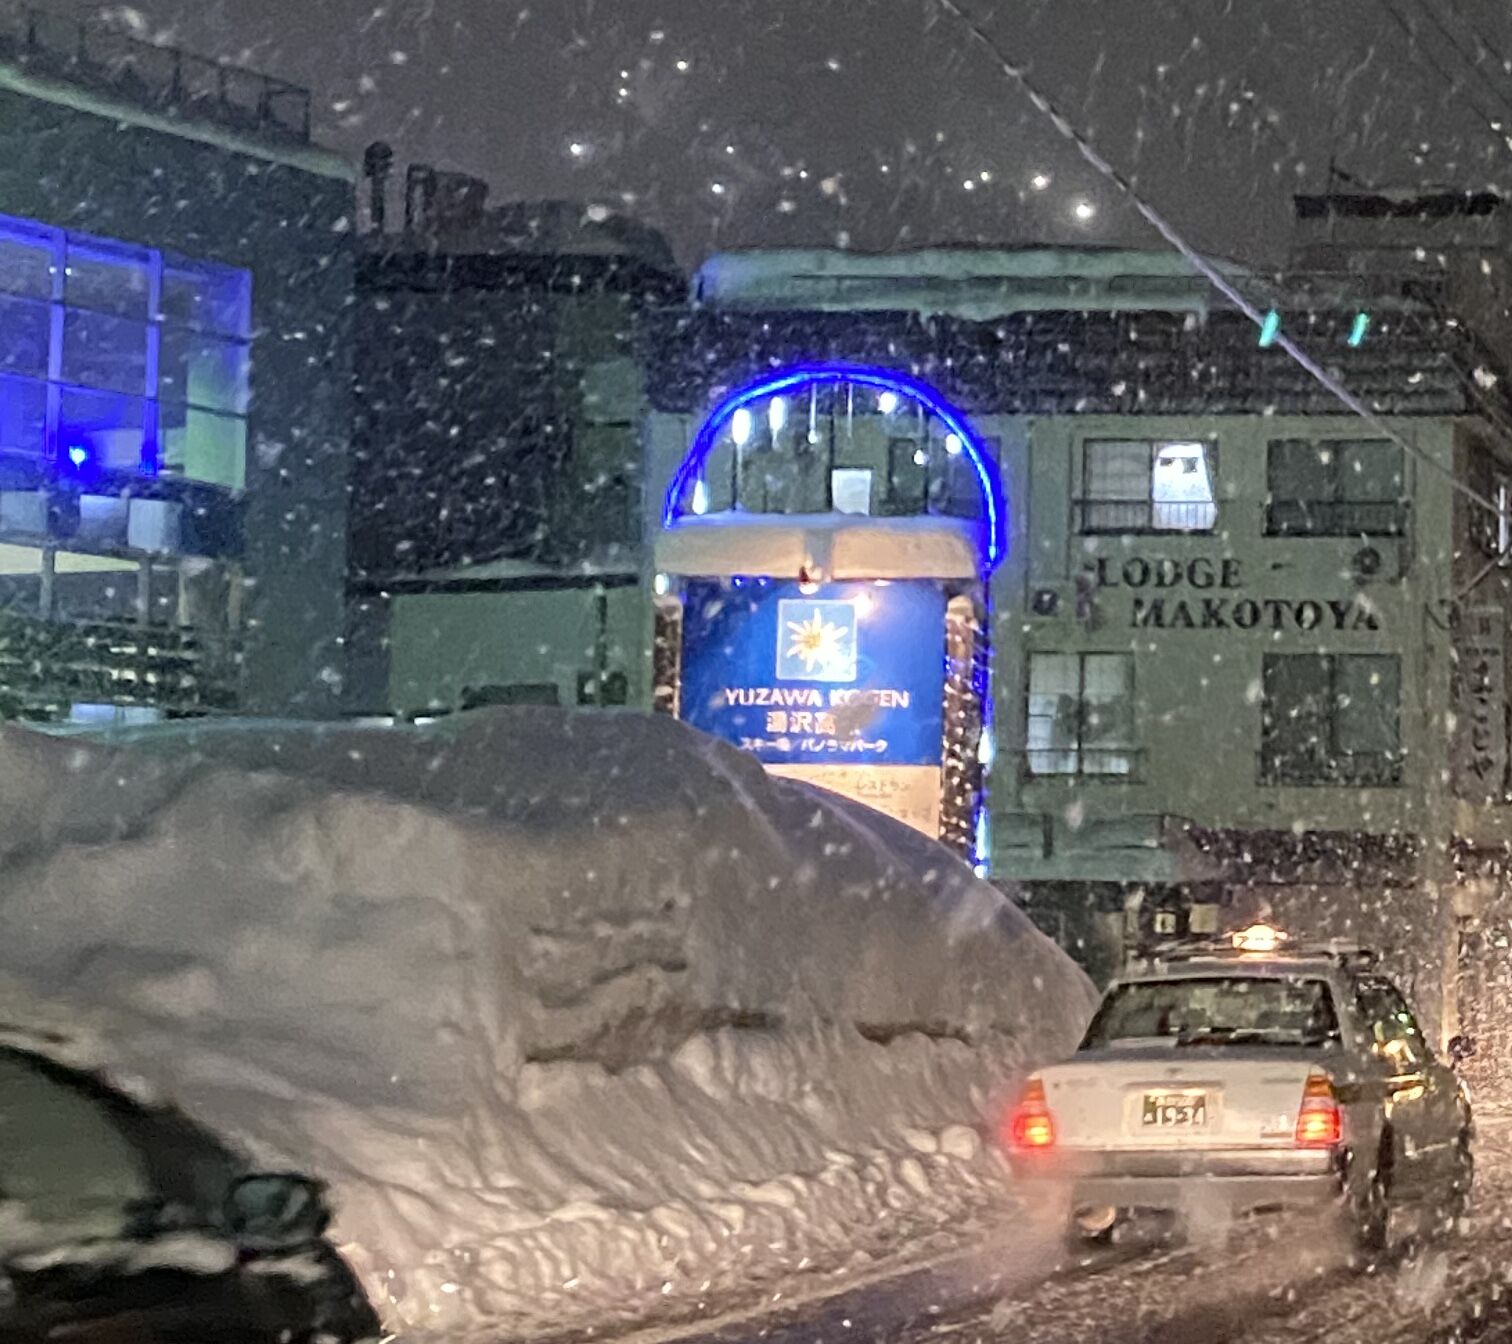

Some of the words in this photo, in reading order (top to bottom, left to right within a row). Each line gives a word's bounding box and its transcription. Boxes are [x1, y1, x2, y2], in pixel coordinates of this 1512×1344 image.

[1096, 557, 1242, 589] LODGE
[1131, 598, 1379, 631] MAKOTOYA
[725, 688, 823, 707] YUZAWA
[830, 688, 910, 708] KEN
[765, 710, 860, 736] 湯沢高
